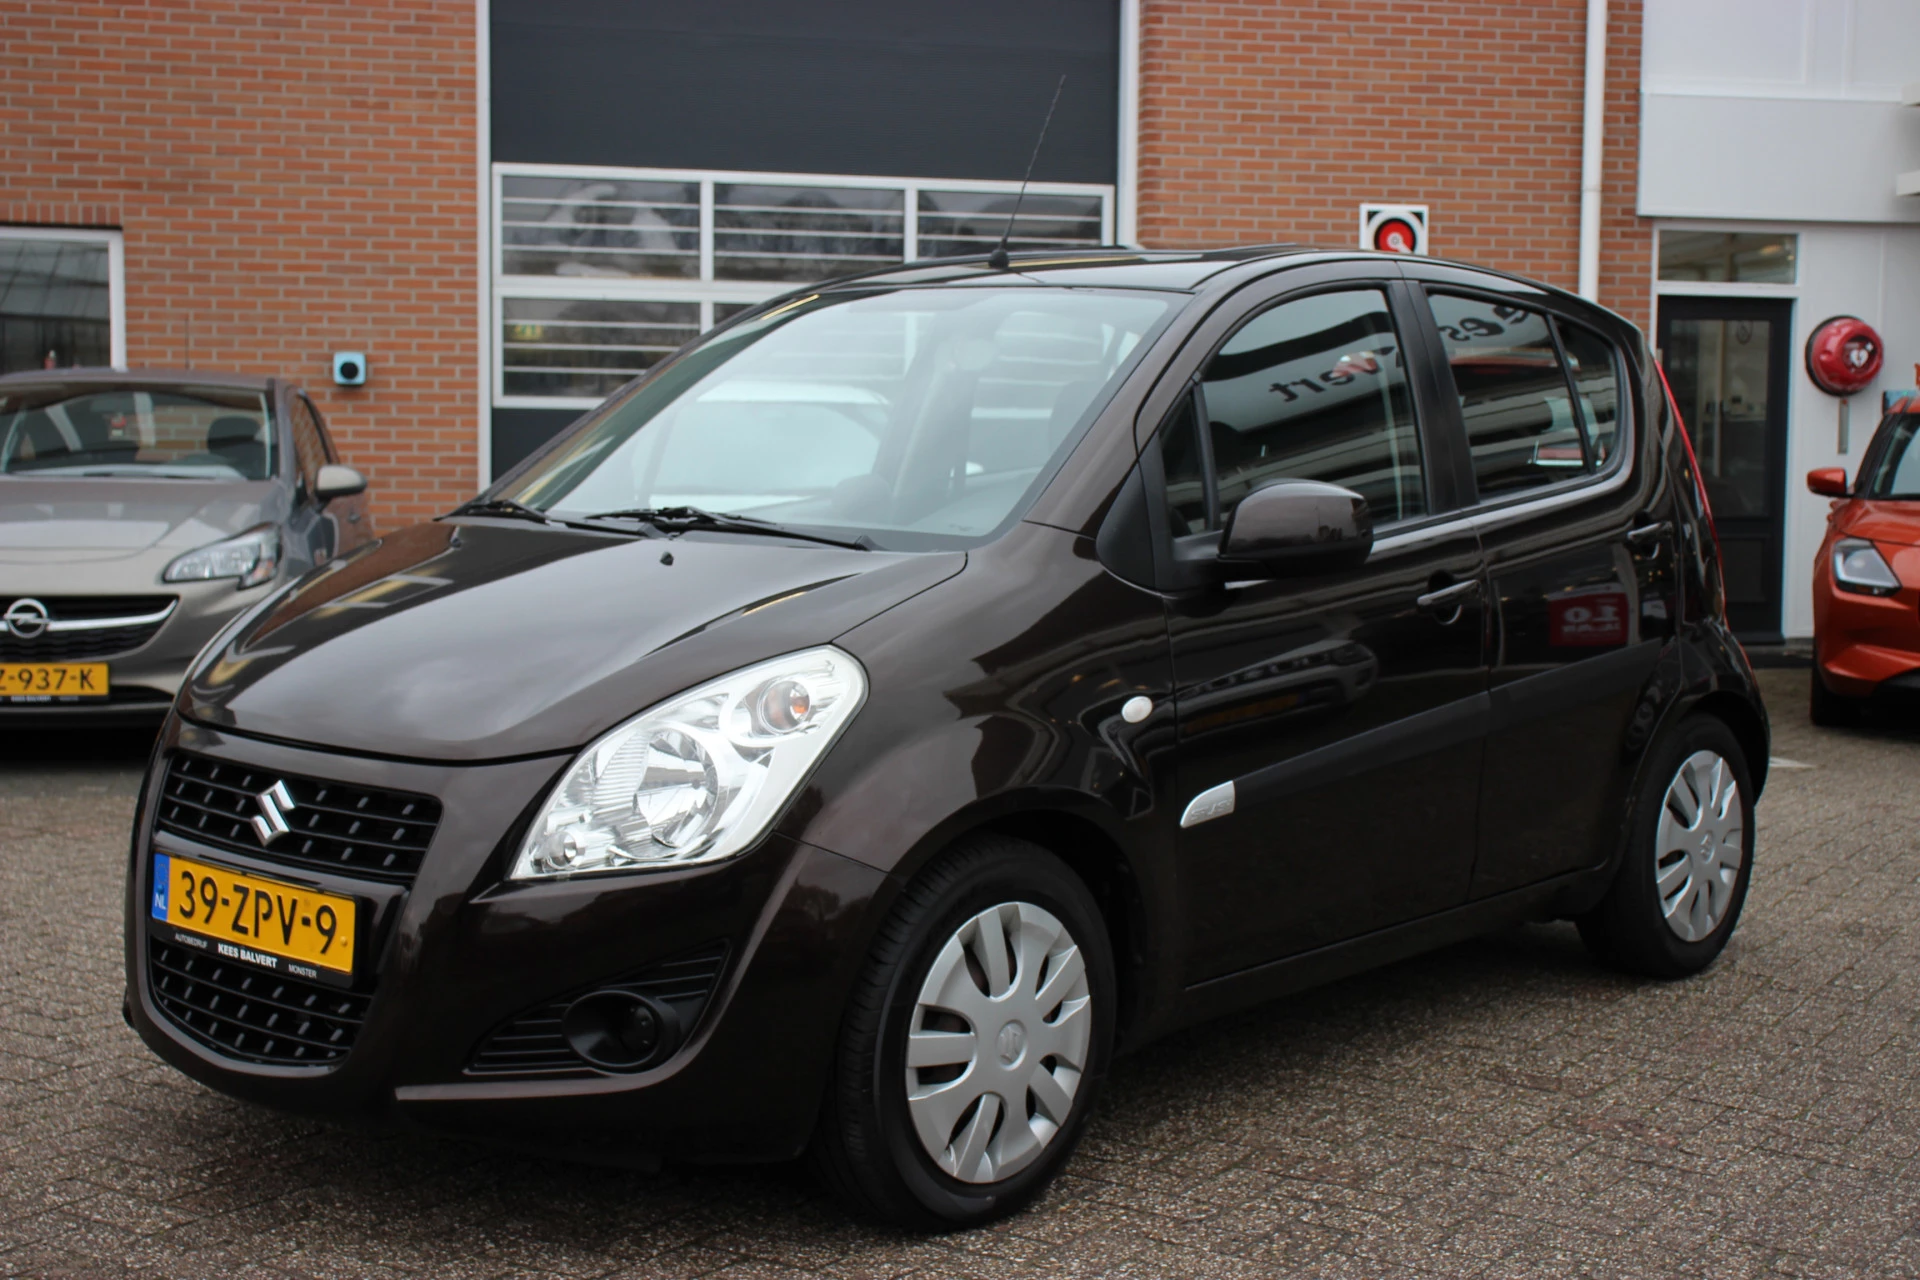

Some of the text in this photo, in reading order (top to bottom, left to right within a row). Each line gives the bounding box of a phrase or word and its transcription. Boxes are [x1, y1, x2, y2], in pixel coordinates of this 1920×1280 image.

[154, 892, 167, 910] NL
[178, 870, 337, 955] 39-ZPV-9
[218, 943, 239, 959] KEES
[240, 947, 277, 969] BALVERT
[288, 964, 317, 979] MONSTER
